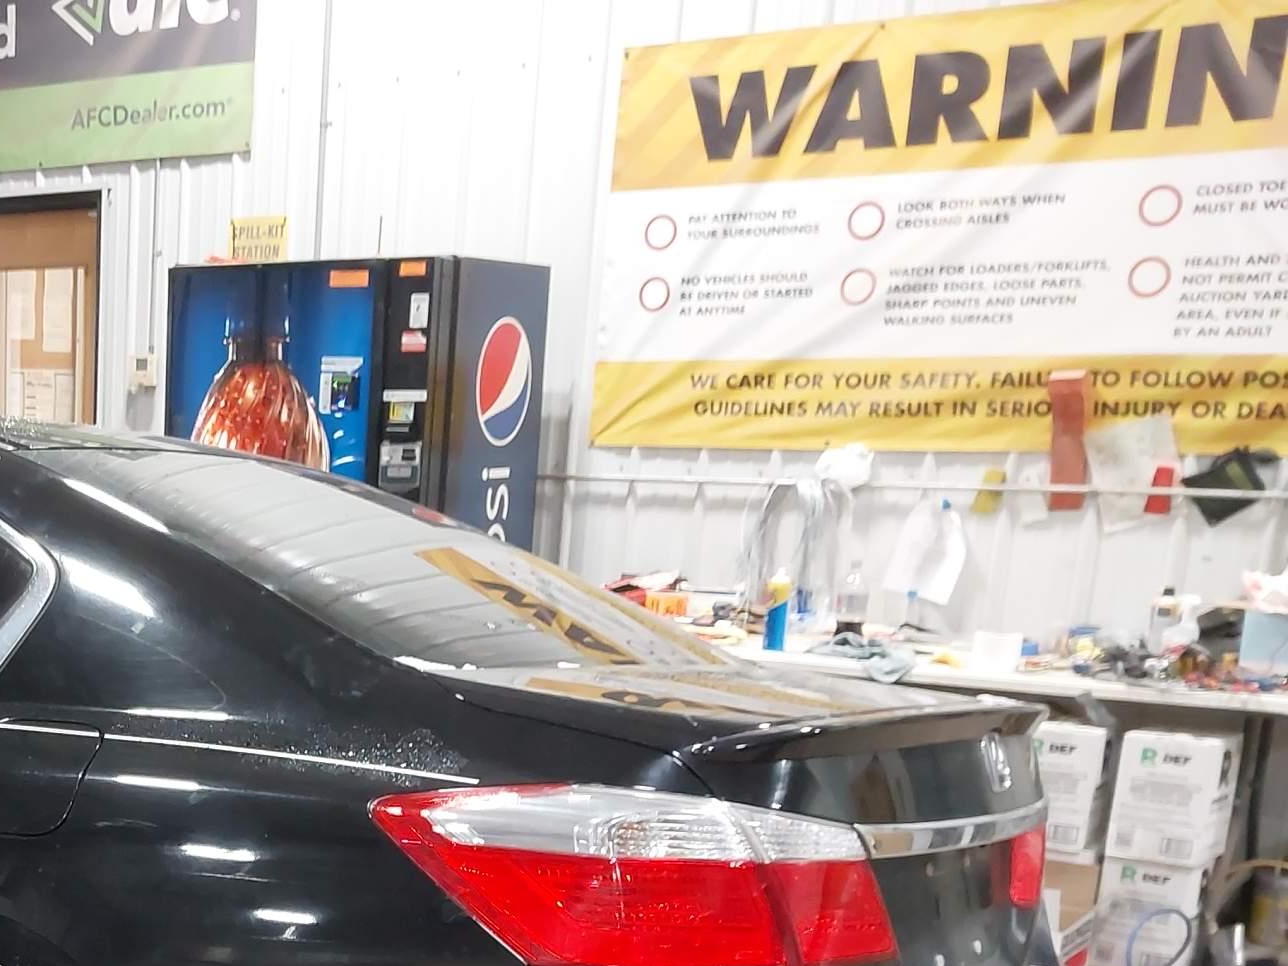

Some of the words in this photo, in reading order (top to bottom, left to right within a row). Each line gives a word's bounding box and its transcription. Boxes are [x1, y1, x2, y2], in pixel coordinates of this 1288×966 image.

[690, 15, 1288, 162] WARNIN
[71, 100, 226, 131] AFCDealer.com
[1196, 182, 1253, 197] CLOSED
[897, 200, 934, 213] LOOK
[939, 198, 974, 210] BOTH
[979, 195, 1017, 207] WAYS
[1021, 193, 1066, 205] WHEN
[1193, 202, 1234, 215] MUST
[1240, 200, 1256, 212] BE
[712, 210, 777, 223] ATTENTION
[782, 208, 797, 220] TO
[895, 216, 962, 230] CROSSING
[967, 211, 1010, 225] AISLES
[722, 224, 820, 239] SURROUNDINGS
[234, 244, 280, 259] STATION
[1184, 254, 1240, 268] HEALTH
[1245, 252, 1281, 266] AND
[681, 275, 700, 286] NO
[704, 273, 755, 285] VEHICLES
[759, 271, 808, 283] SHOULD
[889, 265, 935, 278] WATCH
[939, 264, 965, 276] FOR
[1181, 273, 1214, 286] NOT
[1218, 271, 1272, 285] PERMIT
[680, 291, 692, 302] BE
[697, 290, 739, 301] DRIVEN
[742, 288, 759, 300] OR
[764, 287, 814, 299] STARTED
[886, 283, 939, 295] JAGGED
[993, 279, 1036, 291] LOOSE
[884, 298, 930, 311] SHARP
[933, 297, 980, 310] POINTS
[986, 296, 1015, 308] AND
[1020, 294, 1077, 306] UNEVEN
[1179, 290, 1246, 304] AUCTION
[679, 305, 692, 316] AT
[696, 304, 745, 316] ANYTIME
[1225, 307, 1264, 320] EVEN
[883, 315, 945, 327] WALKING
[949, 312, 1013, 325] SURFACES
[1173, 326, 1192, 338] BY
[1196, 326, 1220, 338] AN
[1224, 325, 1273, 338] ADULT
[690, 374, 718, 390] WE
[726, 373, 775, 389] CARE
[783, 373, 823, 389] FOR
[832, 373, 890, 389] YOUR
[990, 370, 1049, 389] FAILU
[1091, 370, 1121, 387] TO
[1129, 370, 1235, 388] FOLLOW
[693, 399, 807, 417] GUIDELINES
[814, 400, 861, 417] MAY
[869, 399, 942, 417] RESULT
[952, 400, 976, 417] IN
[985, 399, 1052, 418] SERIO
[1093, 400, 1180, 418] INJURY
[1191, 400, 1225, 418] OR
